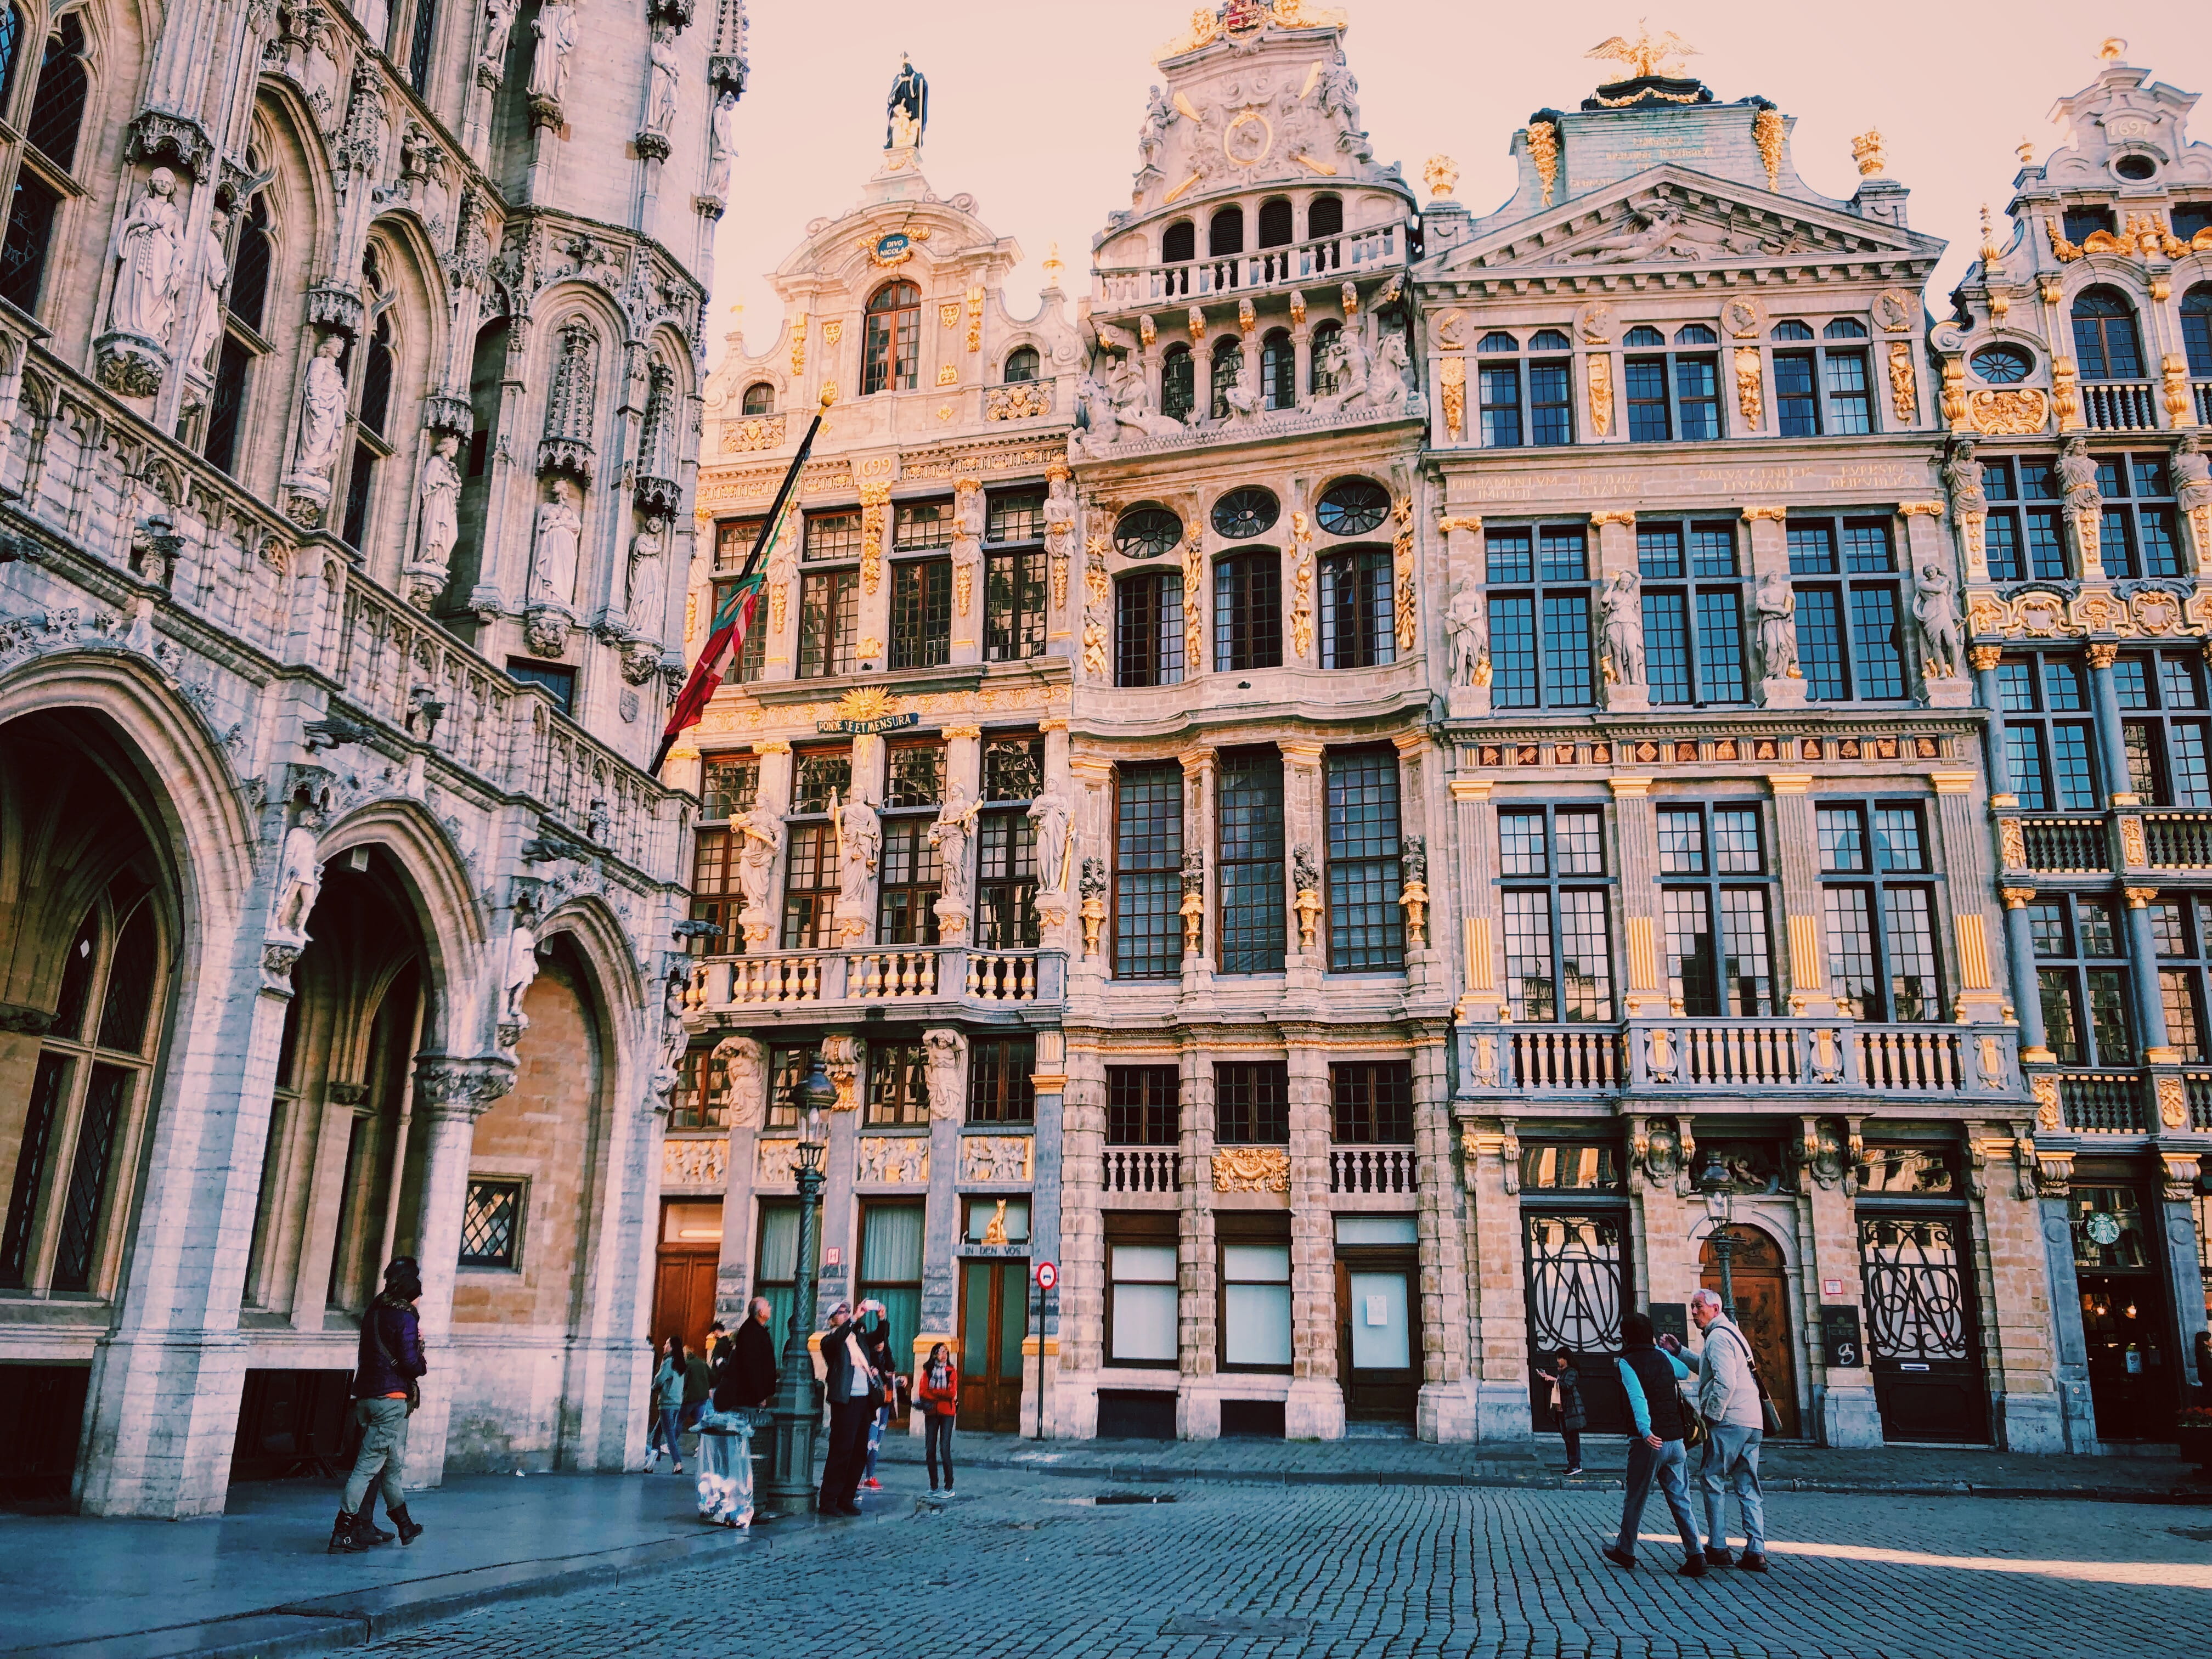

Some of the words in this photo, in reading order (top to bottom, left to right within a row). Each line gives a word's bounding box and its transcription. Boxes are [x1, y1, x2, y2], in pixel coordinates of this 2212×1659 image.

[2108, 121, 2150, 136] 1697
[887, 240, 904, 248] DIVO
[880, 246, 910, 256] NICOLAO
[855, 457, 891, 477] 1699
[854, 721, 866, 733] ET
[867, 714, 911, 733] MENSURA
[965, 1245, 974, 1255] IN
[979, 1245, 997, 1255] DEN
[1004, 1245, 1022, 1256] VOS
